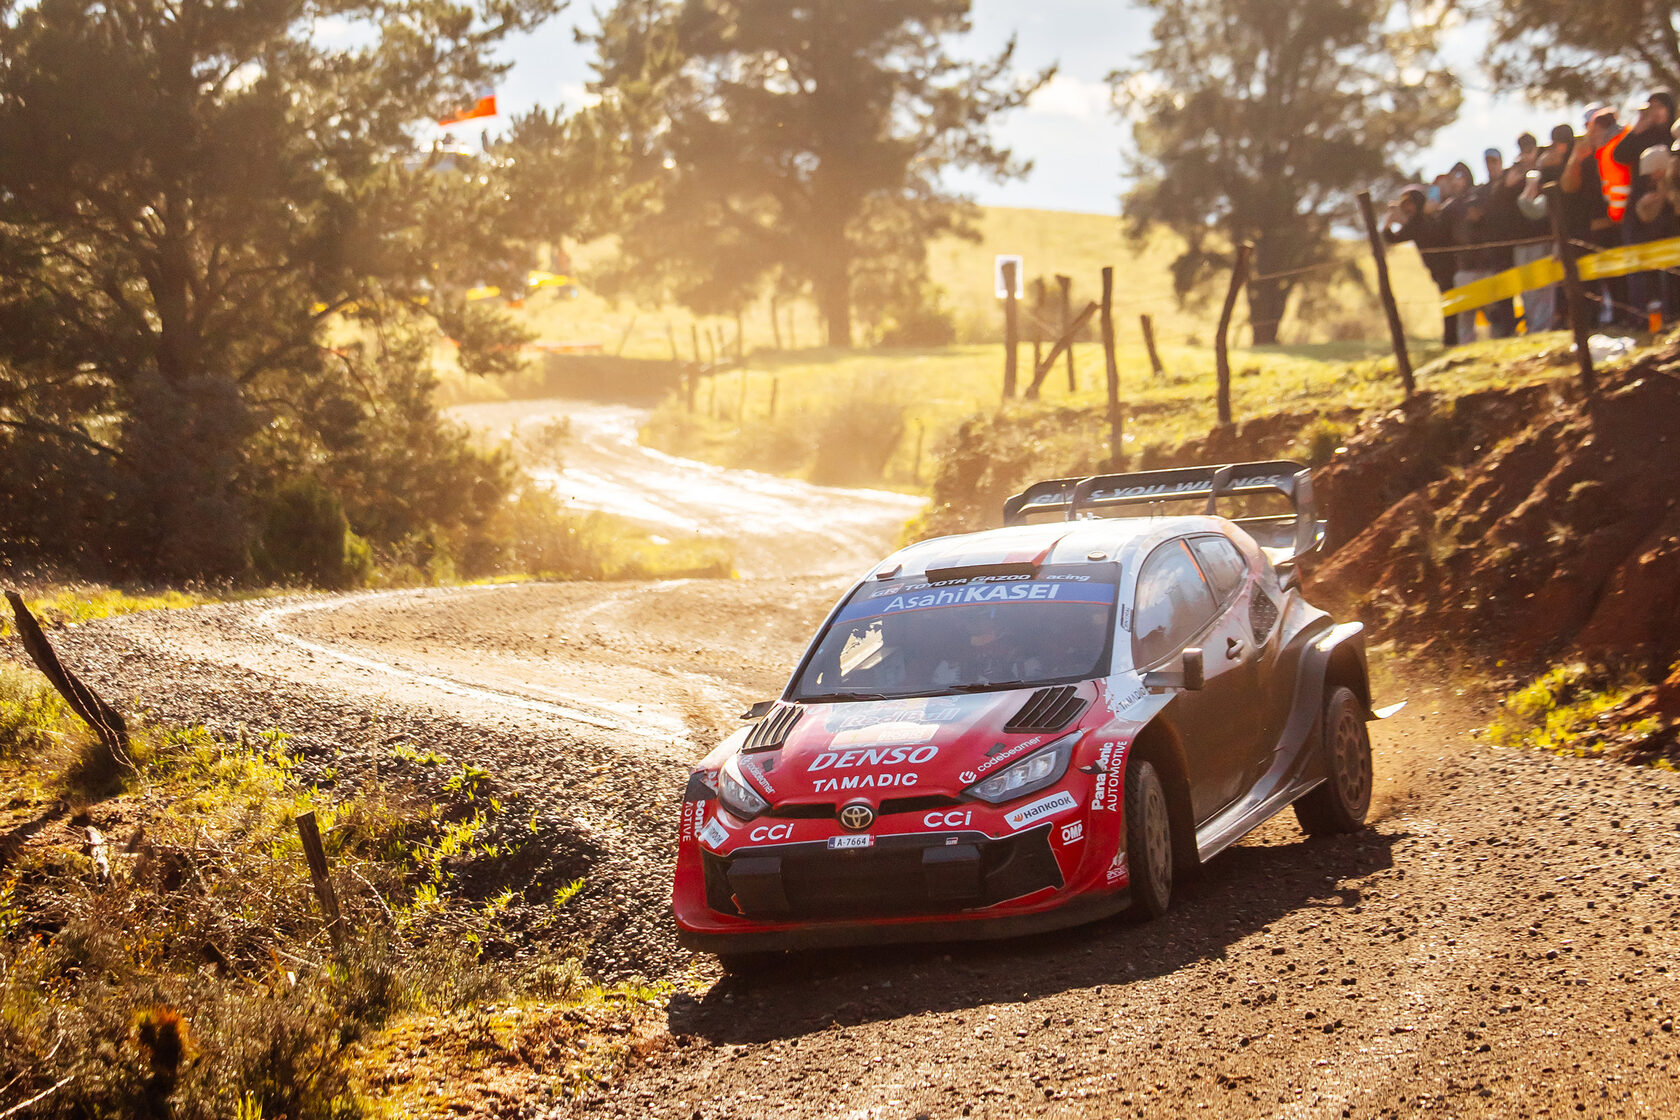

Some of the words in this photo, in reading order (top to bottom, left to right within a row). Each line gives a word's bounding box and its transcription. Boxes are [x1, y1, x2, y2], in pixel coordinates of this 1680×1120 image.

[1113, 483, 1165, 497] YOU
[904, 578, 967, 591] TOYOTA
[971, 574, 1031, 583] GAZOO
[807, 745, 939, 772] DENSO
[977, 735, 1040, 773] codebeamer
[812, 772, 919, 792] TAMADIC
[1107, 740, 1128, 812] AUTOMOTIVE
[836, 837, 867, 847] A-7664
[1061, 824, 1083, 842] OMP
